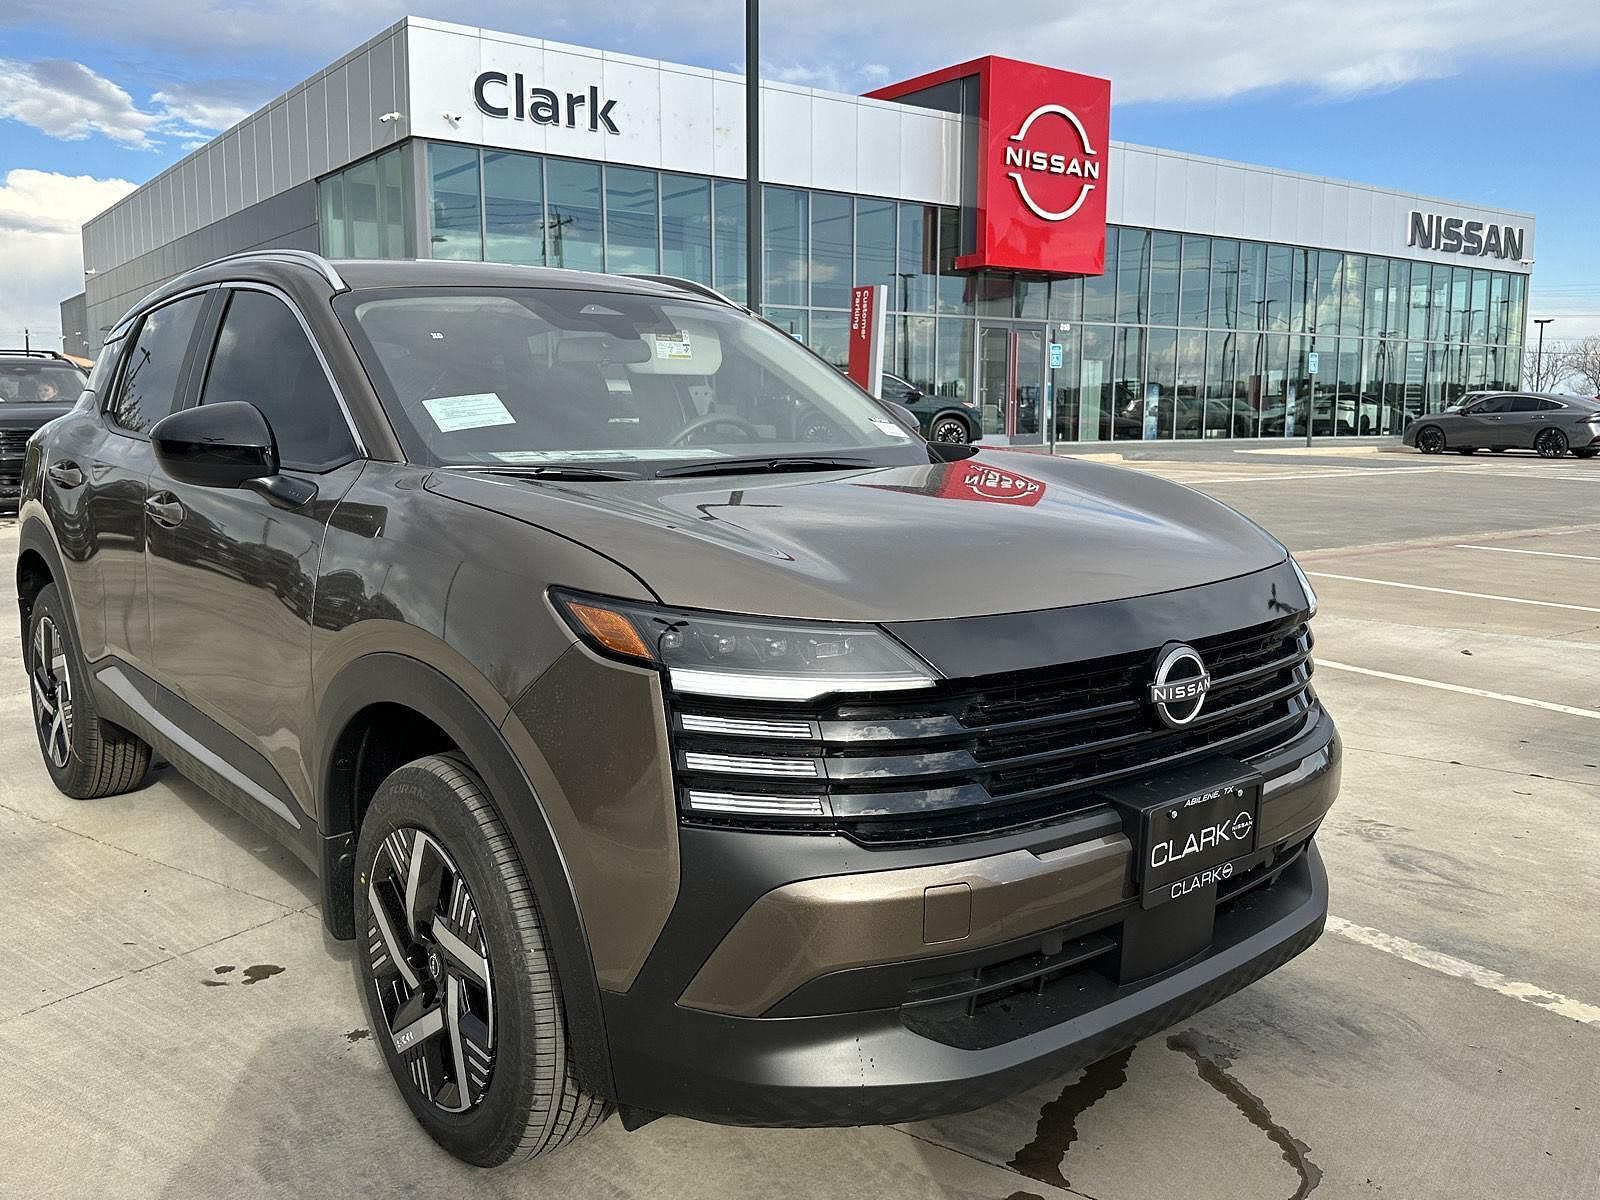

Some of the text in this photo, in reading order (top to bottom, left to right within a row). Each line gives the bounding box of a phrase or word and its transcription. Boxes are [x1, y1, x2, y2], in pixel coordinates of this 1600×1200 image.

[473, 71, 621, 135] Clark
[1006, 146, 1100, 179] NISSAN
[1407, 211, 1524, 261] NISSAN
[852, 291, 861, 330] Parking
[860, 290, 869, 340] Customer
[1154, 676, 1210, 701] NISSAN
[1224, 785, 1235, 795] TX
[1151, 819, 1231, 868] CLARK
[1171, 866, 1222, 899] CLARK
